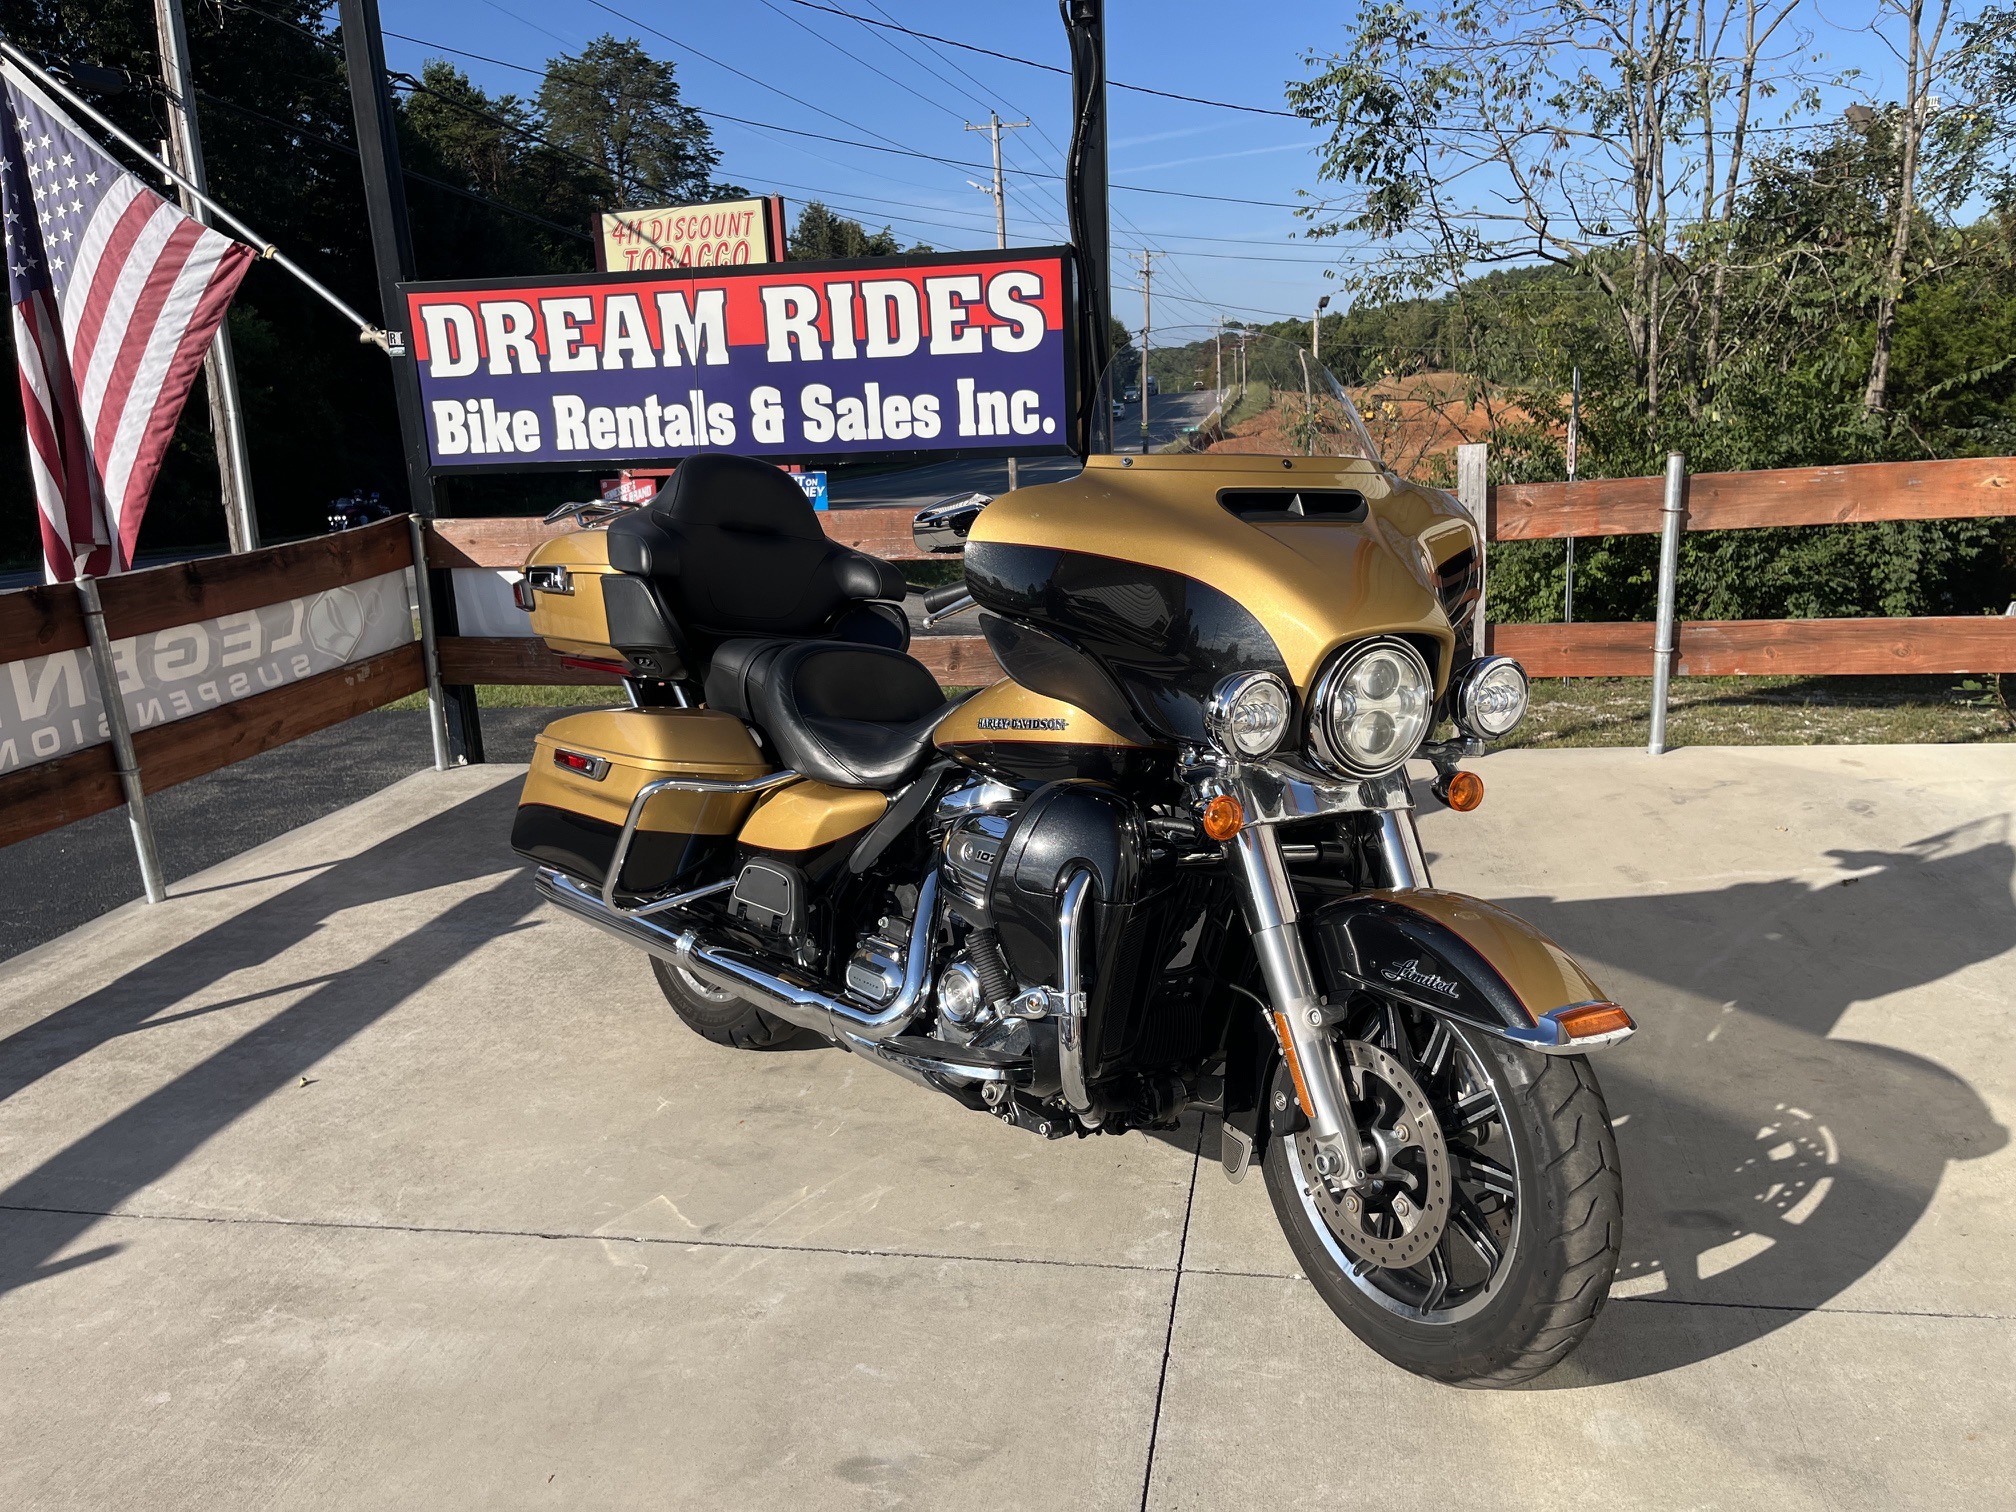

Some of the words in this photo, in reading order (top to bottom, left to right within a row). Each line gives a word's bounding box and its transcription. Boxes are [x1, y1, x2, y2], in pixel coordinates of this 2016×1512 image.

[611, 219, 643, 245] 411
[651, 211, 755, 243] DISCOUNT
[624, 240, 751, 271] TOBACCO
[420, 289, 731, 379] DREAM
[761, 271, 1045, 363] RIDES
[431, 397, 542, 456] Bike
[551, 388, 737, 452] Rentals
[750, 385, 785, 445] &
[800, 382, 943, 443] Sales
[955, 378, 1057, 438] Inc.
[805, 478, 818, 487] ON
[1381, 959, 1460, 998] Limited
